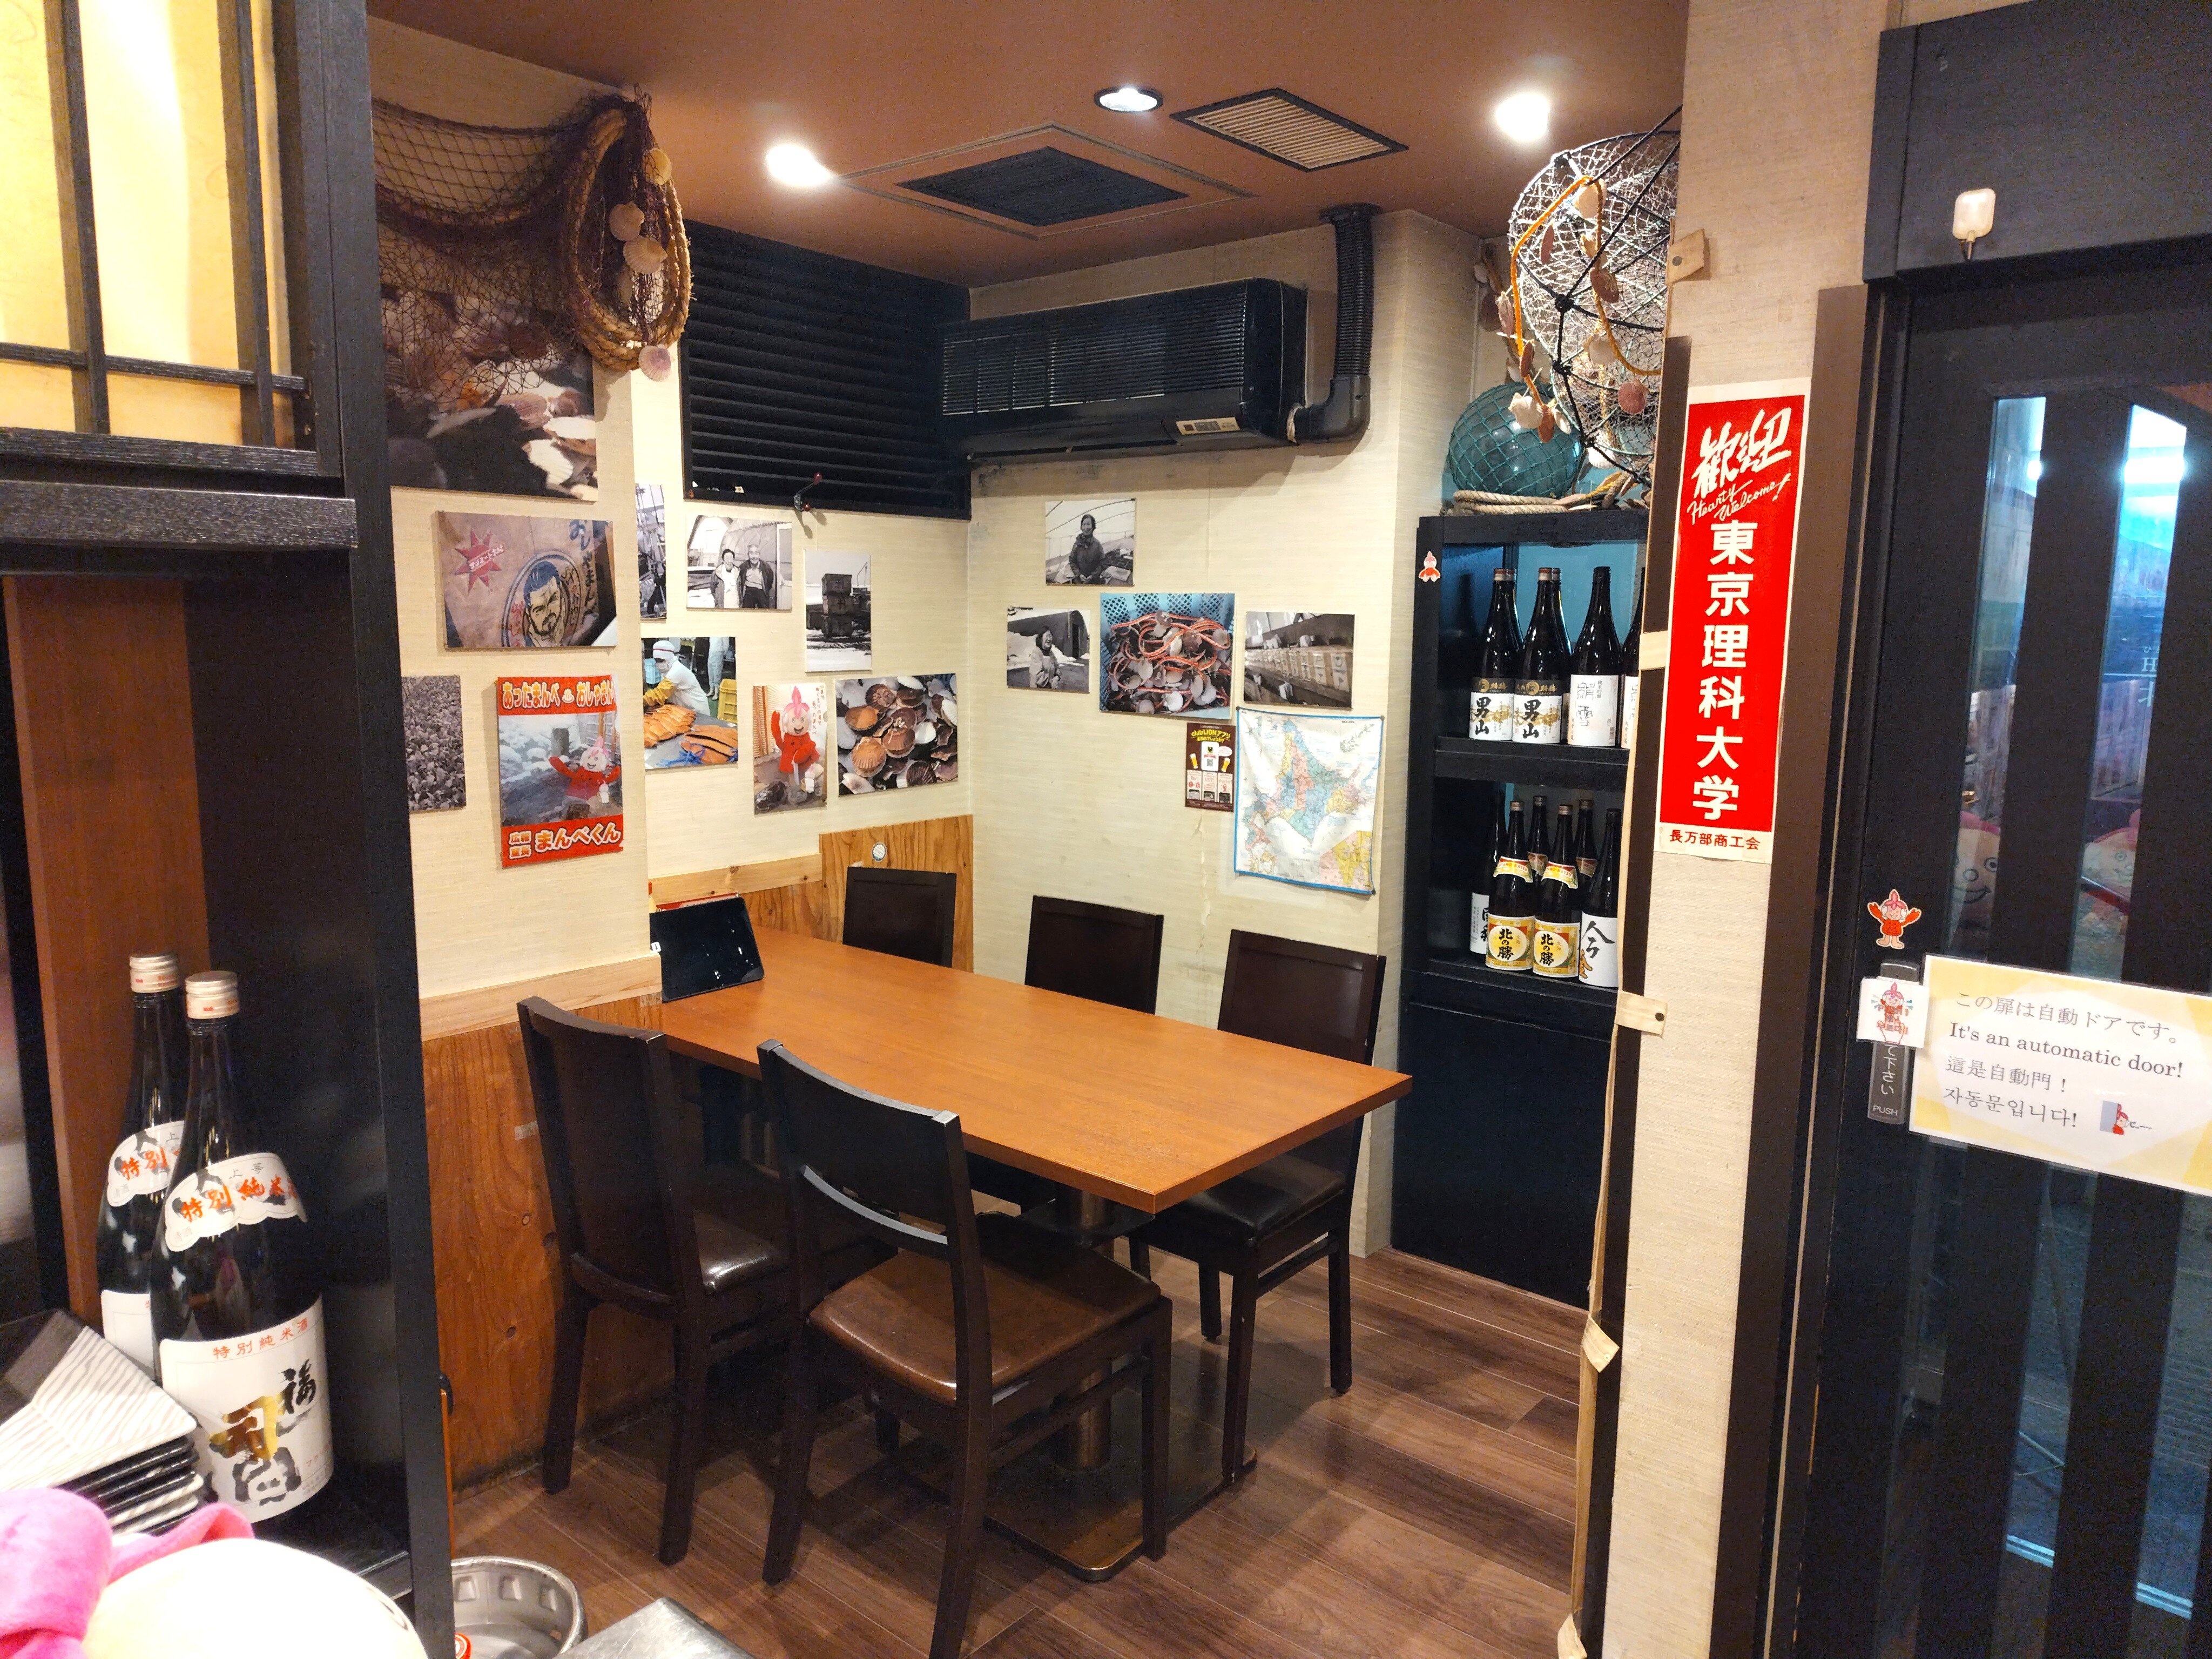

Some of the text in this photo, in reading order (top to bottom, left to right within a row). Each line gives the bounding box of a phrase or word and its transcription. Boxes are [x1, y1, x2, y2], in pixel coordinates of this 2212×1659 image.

[1691, 407, 1792, 499] 歓迎
[1687, 480, 1753, 525] Hearty
[1692, 520, 1758, 820] 東京理科大学
[502, 679, 616, 710] あったまんべ おしゃまん
[1475, 696, 1492, 735] 男山
[1522, 699, 1542, 739] 男山
[535, 821, 622, 853] まんべくん
[1670, 829, 1761, 851] 長万部商工会
[1498, 928, 1513, 960] 北の勝
[1540, 933, 1555, 966] 北の勝
[1956, 992, 2176, 1044] この扉は自動ドアです。
[1950, 1022, 2183, 1078] It's an automatic door!
[1873, 1105, 1898, 1116] PUSH
[1944, 1086, 2078, 1128] 자동문입니다!
[120, 1147, 180, 1181] 特別
[213, 1318, 308, 1359] 特別純米酒
